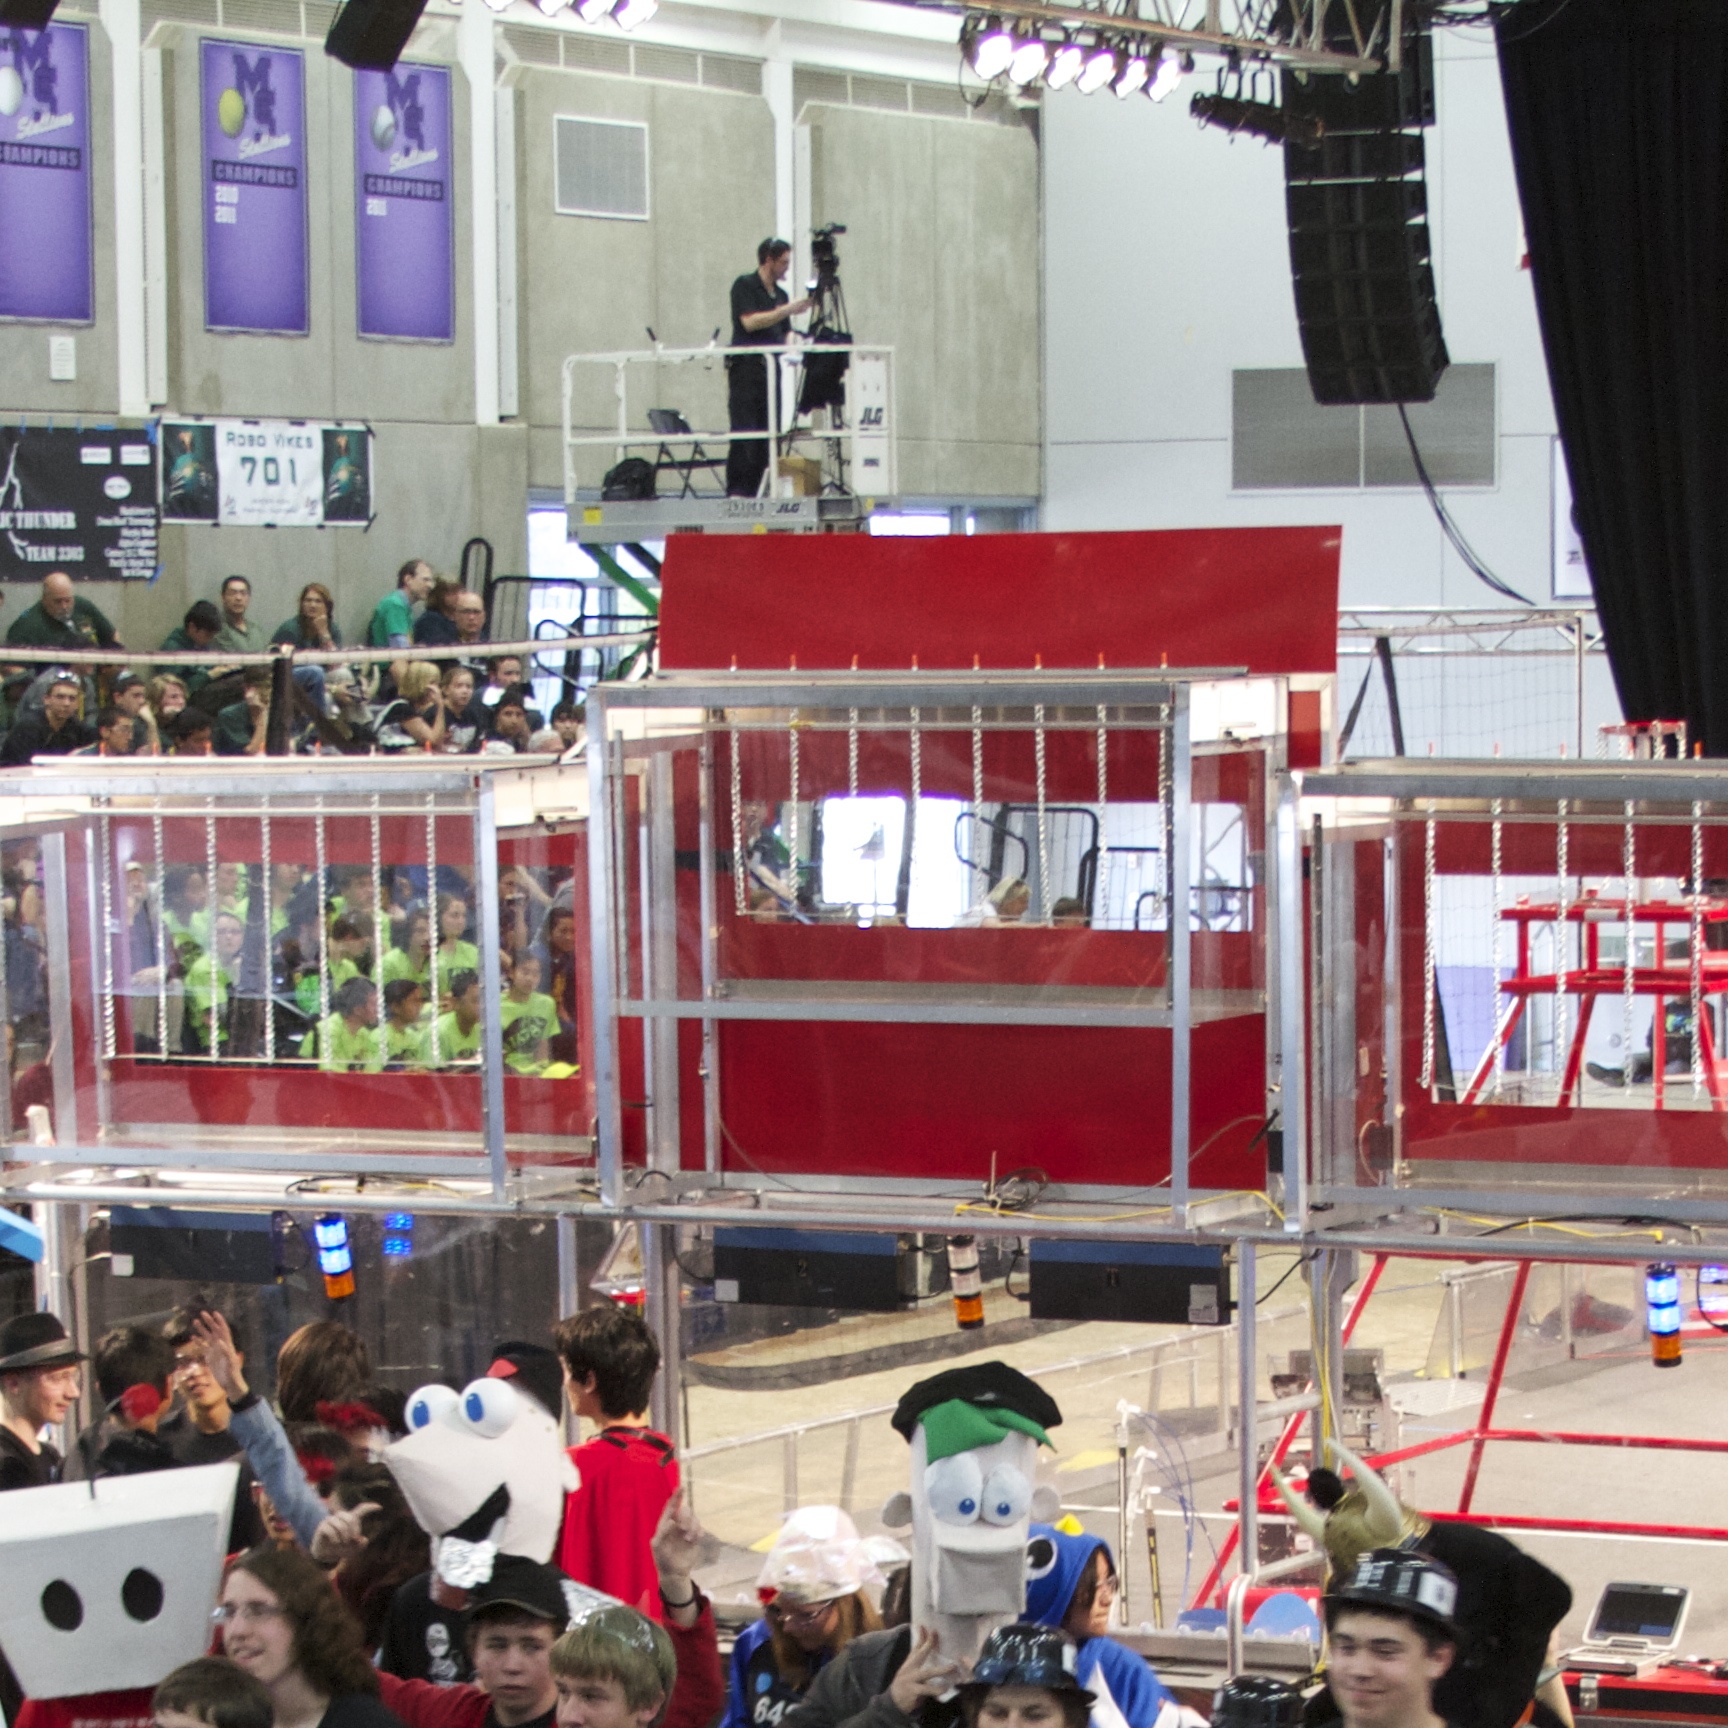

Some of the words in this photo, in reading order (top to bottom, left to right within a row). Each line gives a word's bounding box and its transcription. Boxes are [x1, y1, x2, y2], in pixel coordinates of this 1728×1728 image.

[860, 397, 883, 425] JLG
[240, 456, 297, 486] 701
[15, 511, 77, 530] THUNDER
[25, 546, 57, 562] TEAM
[753, 1696, 801, 1727] 64
